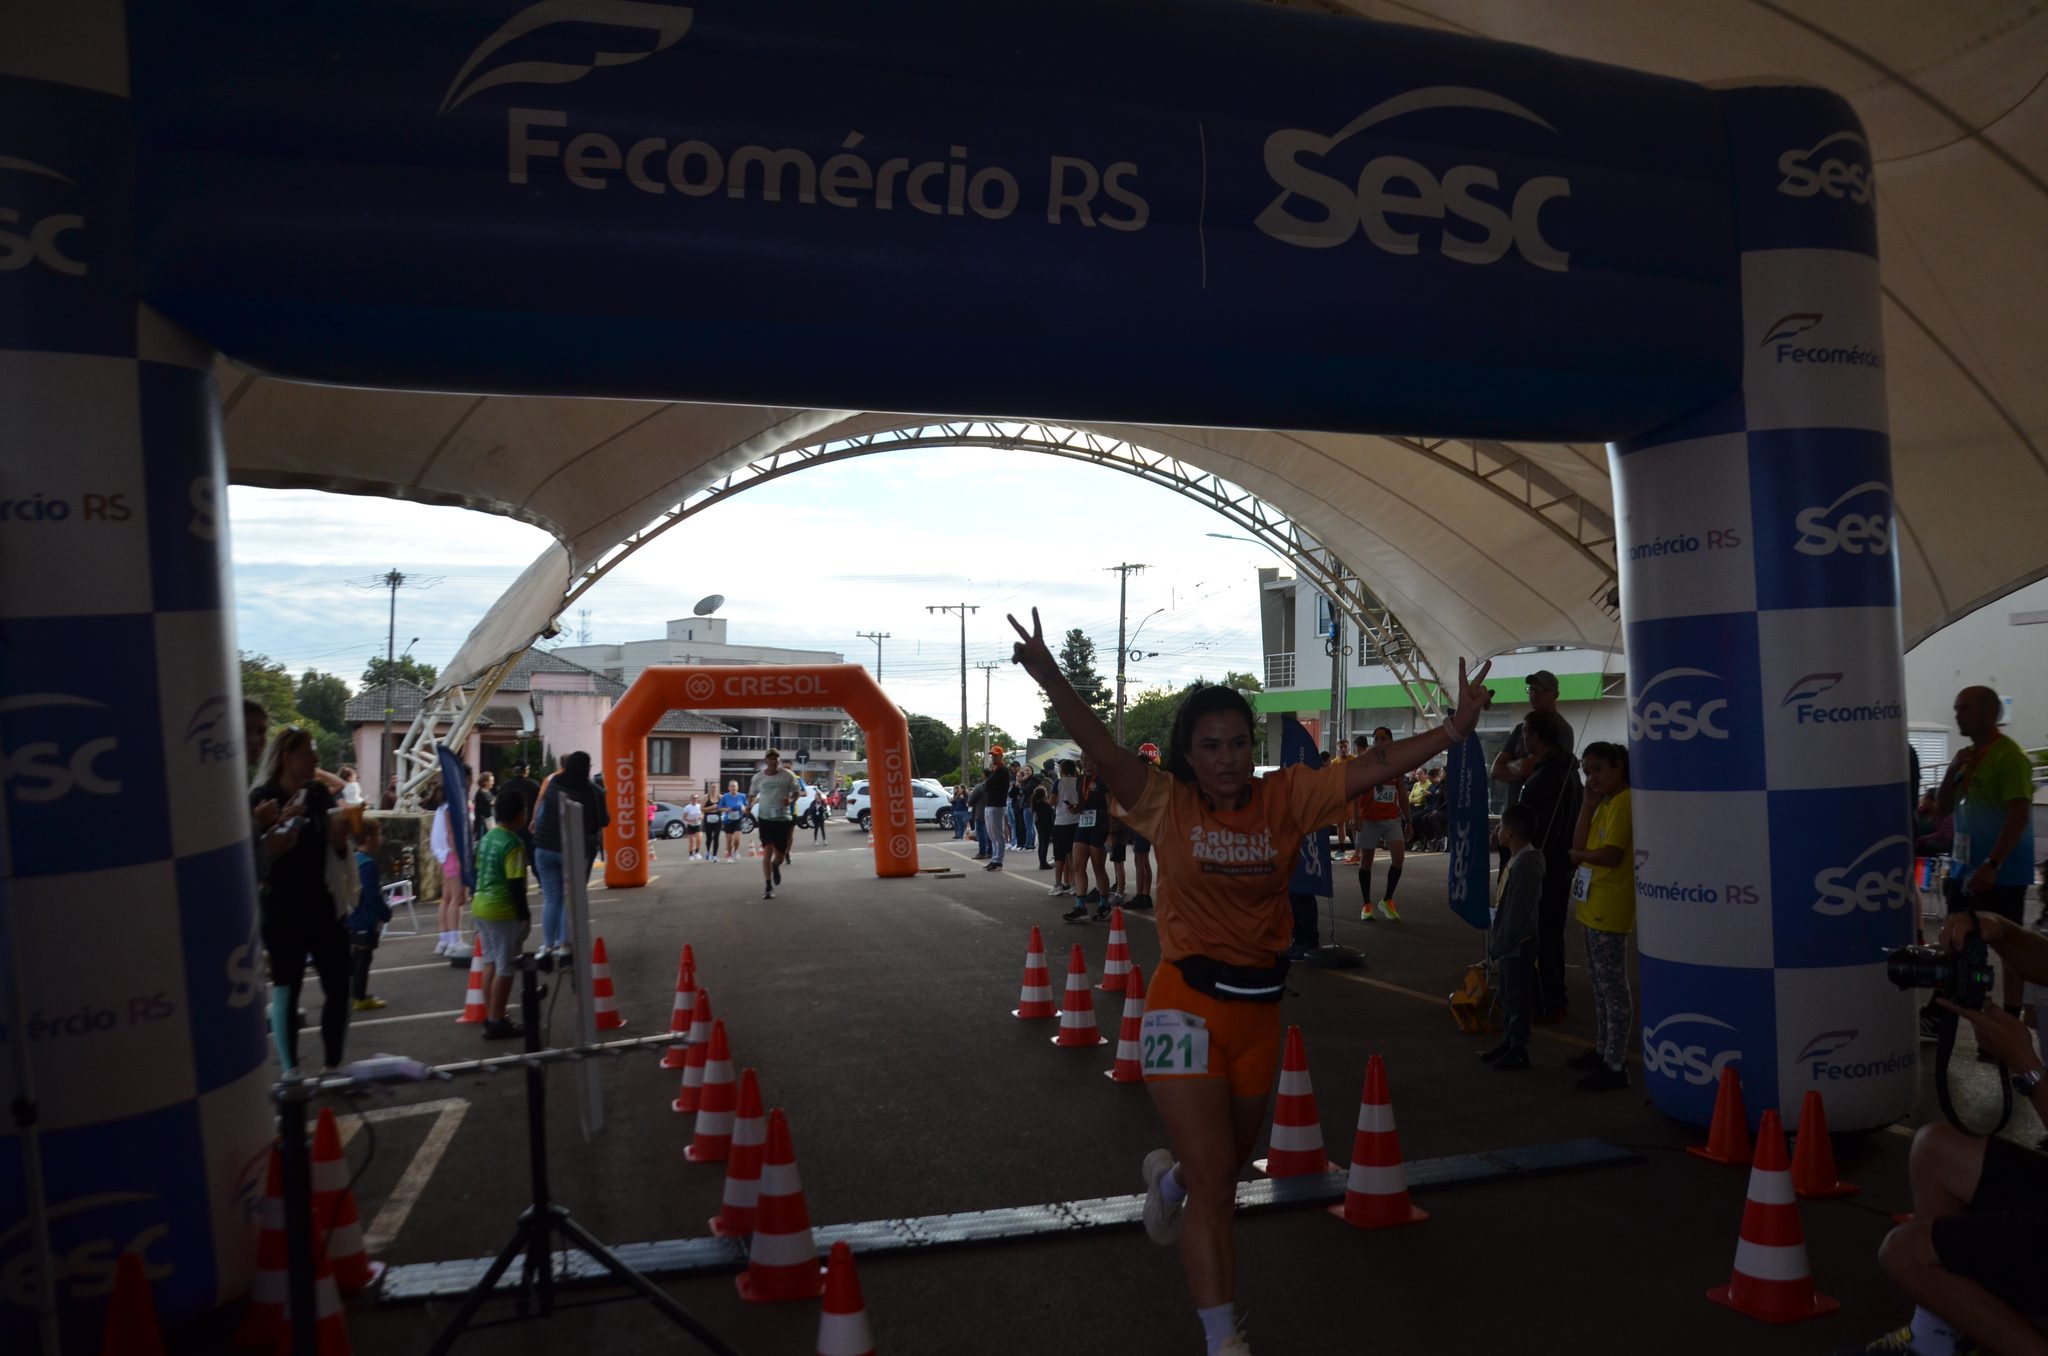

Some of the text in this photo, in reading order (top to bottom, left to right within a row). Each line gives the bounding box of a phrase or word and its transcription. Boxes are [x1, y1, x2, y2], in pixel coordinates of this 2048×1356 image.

[506, 107, 1150, 232] Fecomércio RS
[1254, 127, 1571, 273] Sesc
[0, 493, 132, 522] rcio RS
[1629, 528, 1741, 560] omércio RS
[1793, 507, 1892, 556] Ses
[723, 674, 829, 697] CRESOL
[616, 750, 636, 840] CRESOL
[884, 741, 908, 828] CRESOL
[1635, 880, 1759, 905] ecomércio RS
[128, 993, 175, 1025] RS
[1144, 1033, 1192, 1069] 221
